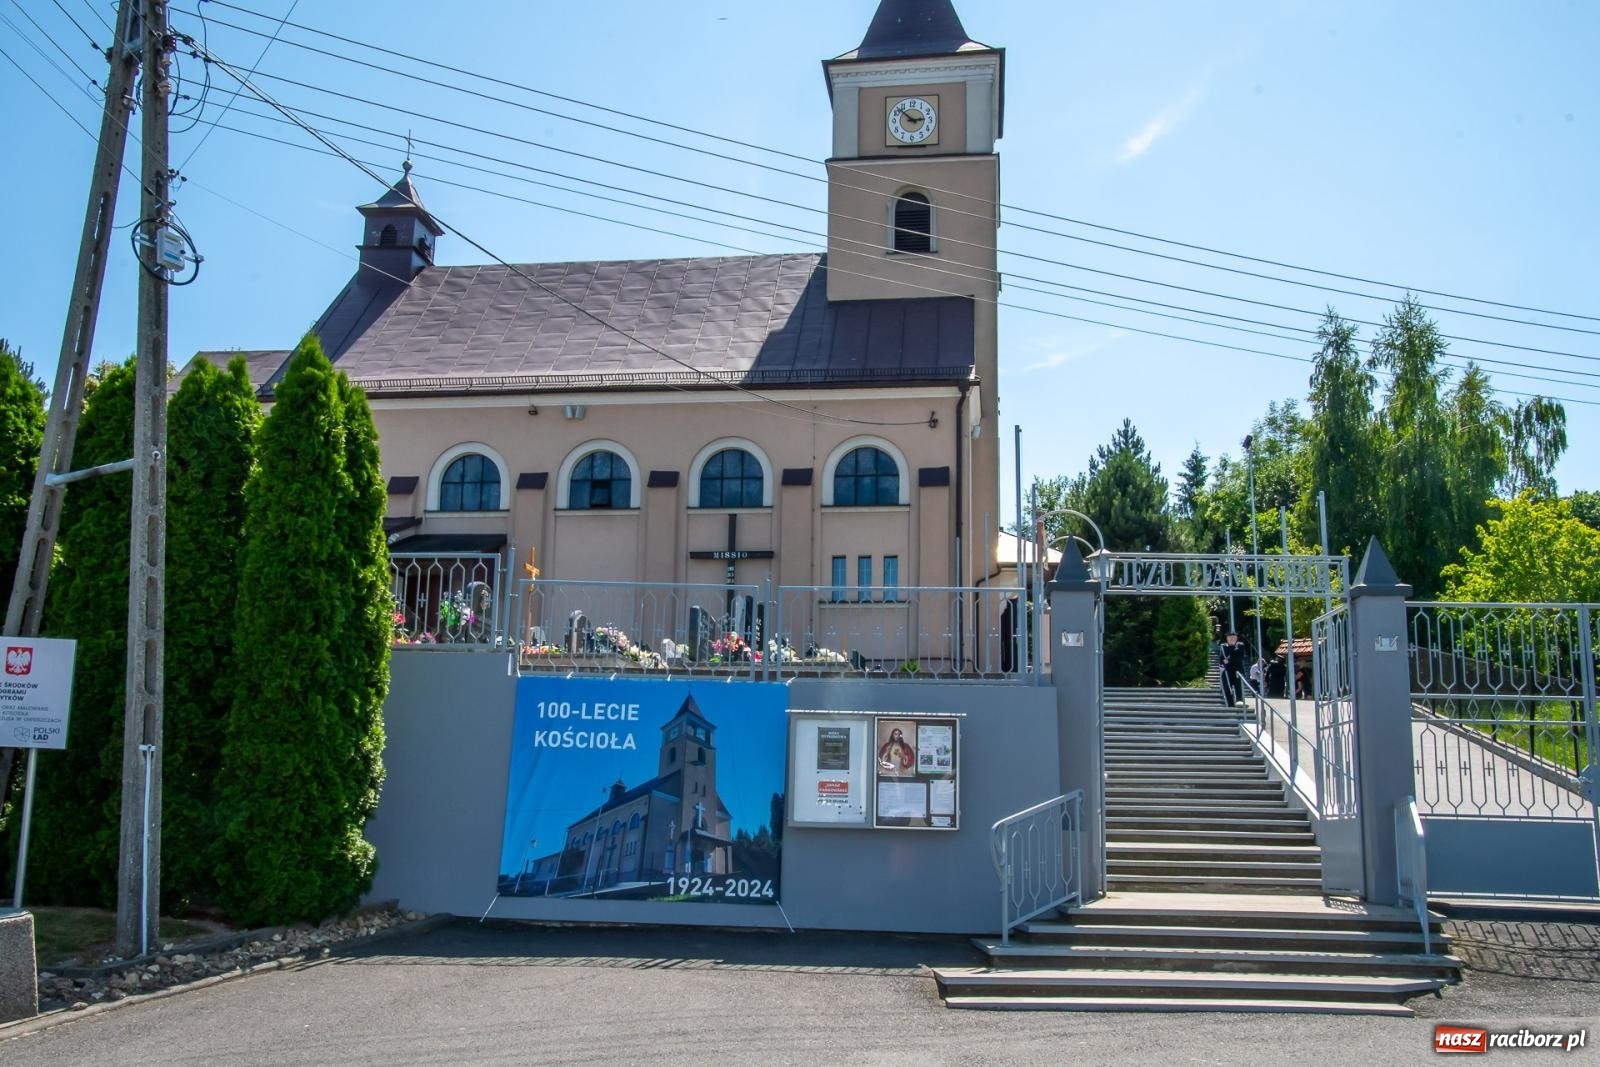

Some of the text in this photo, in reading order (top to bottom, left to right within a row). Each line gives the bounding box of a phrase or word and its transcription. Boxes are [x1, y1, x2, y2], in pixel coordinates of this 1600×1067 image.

[926, 108, 930, 116] 2
[1118, 561, 1174, 588] JEZU
[537, 702, 640, 721] 100-LECIE
[34, 727, 60, 735] POLSKI
[534, 726, 637, 750] KOŚCIOŁA
[666, 877, 774, 898] 1924-2024
